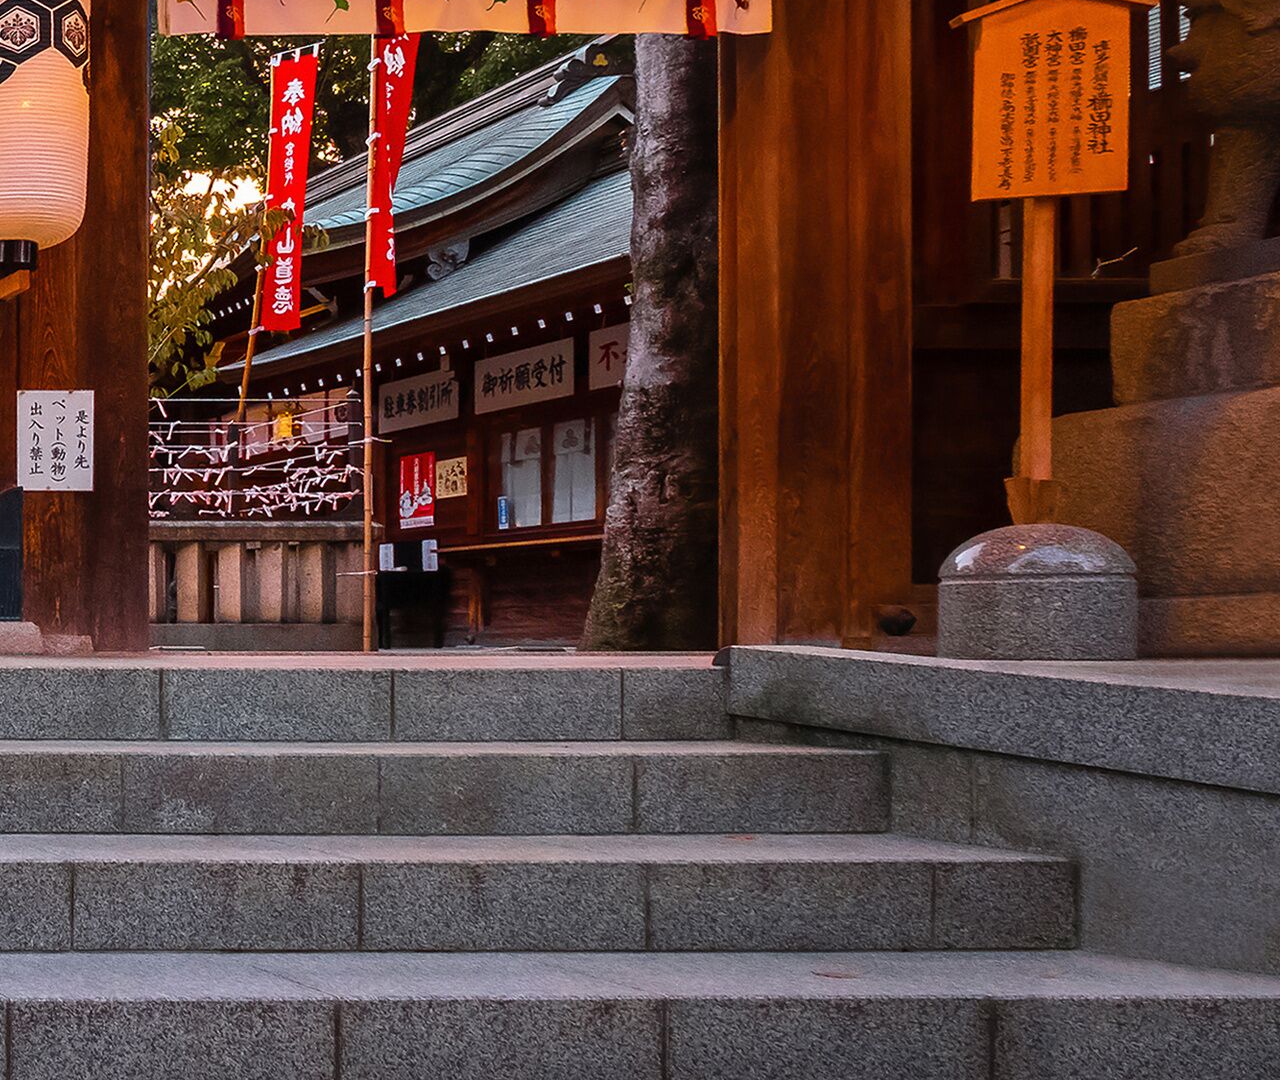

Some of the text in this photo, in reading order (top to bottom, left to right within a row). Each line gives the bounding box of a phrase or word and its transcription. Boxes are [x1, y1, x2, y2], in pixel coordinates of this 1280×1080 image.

[280, 77, 305, 138] 奉納
[481, 353, 569, 398] 御祈願受付
[597, 340, 628, 372] 不
[28, 401, 45, 476] 出入り禁止
[74, 409, 90, 470] 是より先
